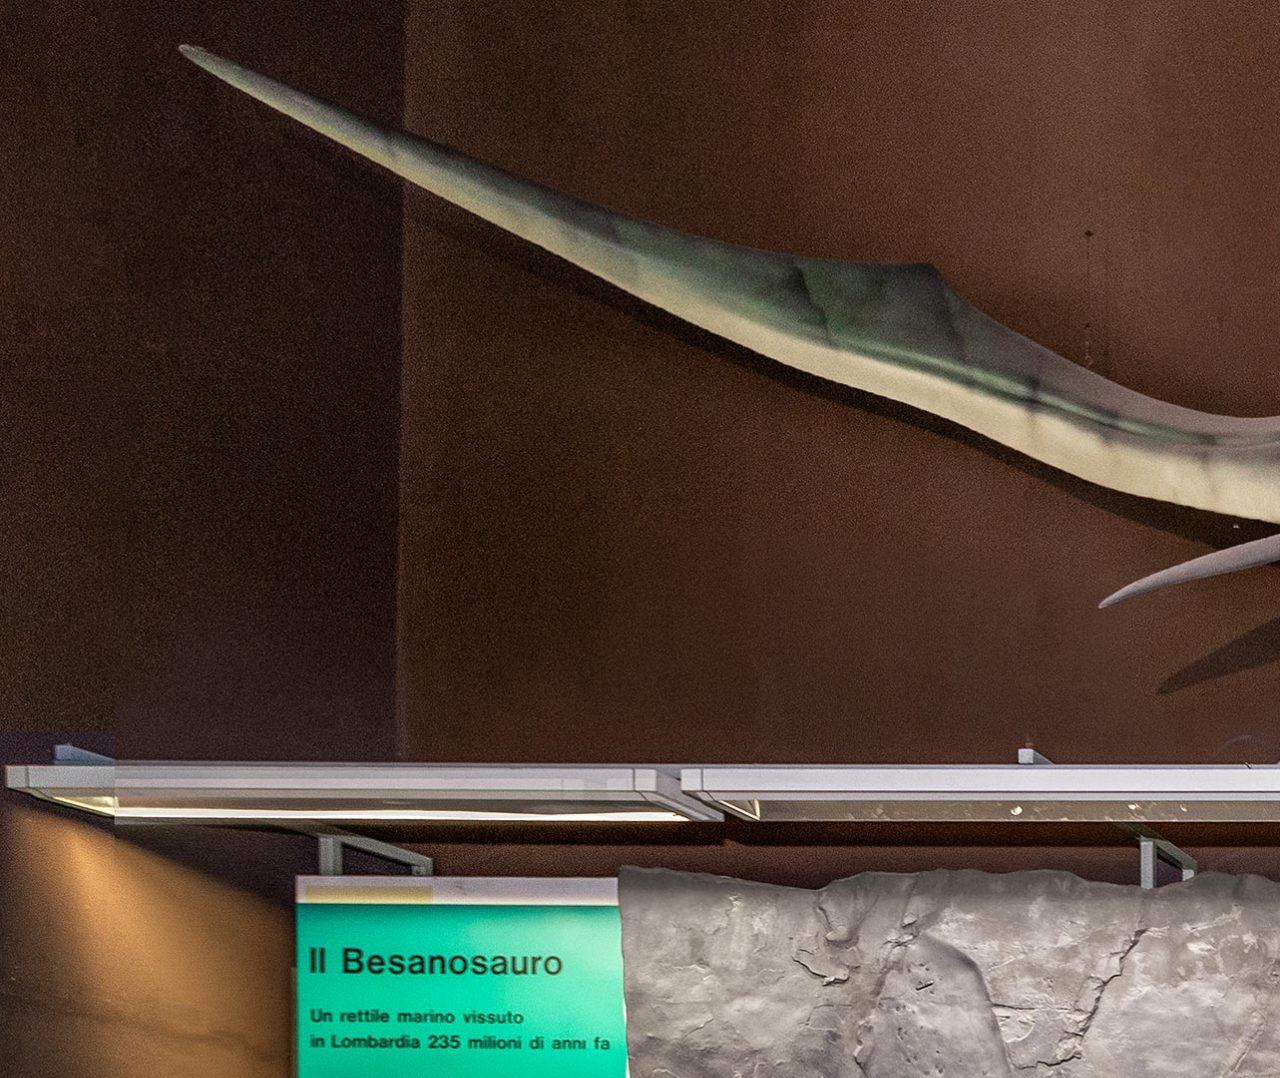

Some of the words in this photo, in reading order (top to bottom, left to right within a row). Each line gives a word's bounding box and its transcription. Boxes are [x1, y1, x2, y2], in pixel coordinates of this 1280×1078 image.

[309, 947, 326, 974] Il
[342, 947, 563, 976] Besanosauro
[310, 1009, 333, 1023] Un
[339, 1009, 390, 1024] rettile
[397, 1010, 455, 1024] marino
[463, 1010, 524, 1024] vissuto
[310, 1034, 325, 1048] in
[331, 1034, 420, 1049] Lombardia
[428, 1034, 461, 1049] 235
[468, 1035, 522, 1049] milioni
[529, 1036, 544, 1050] di
[552, 1037, 586, 1050] anni
[594, 1036, 610, 1050] fa
